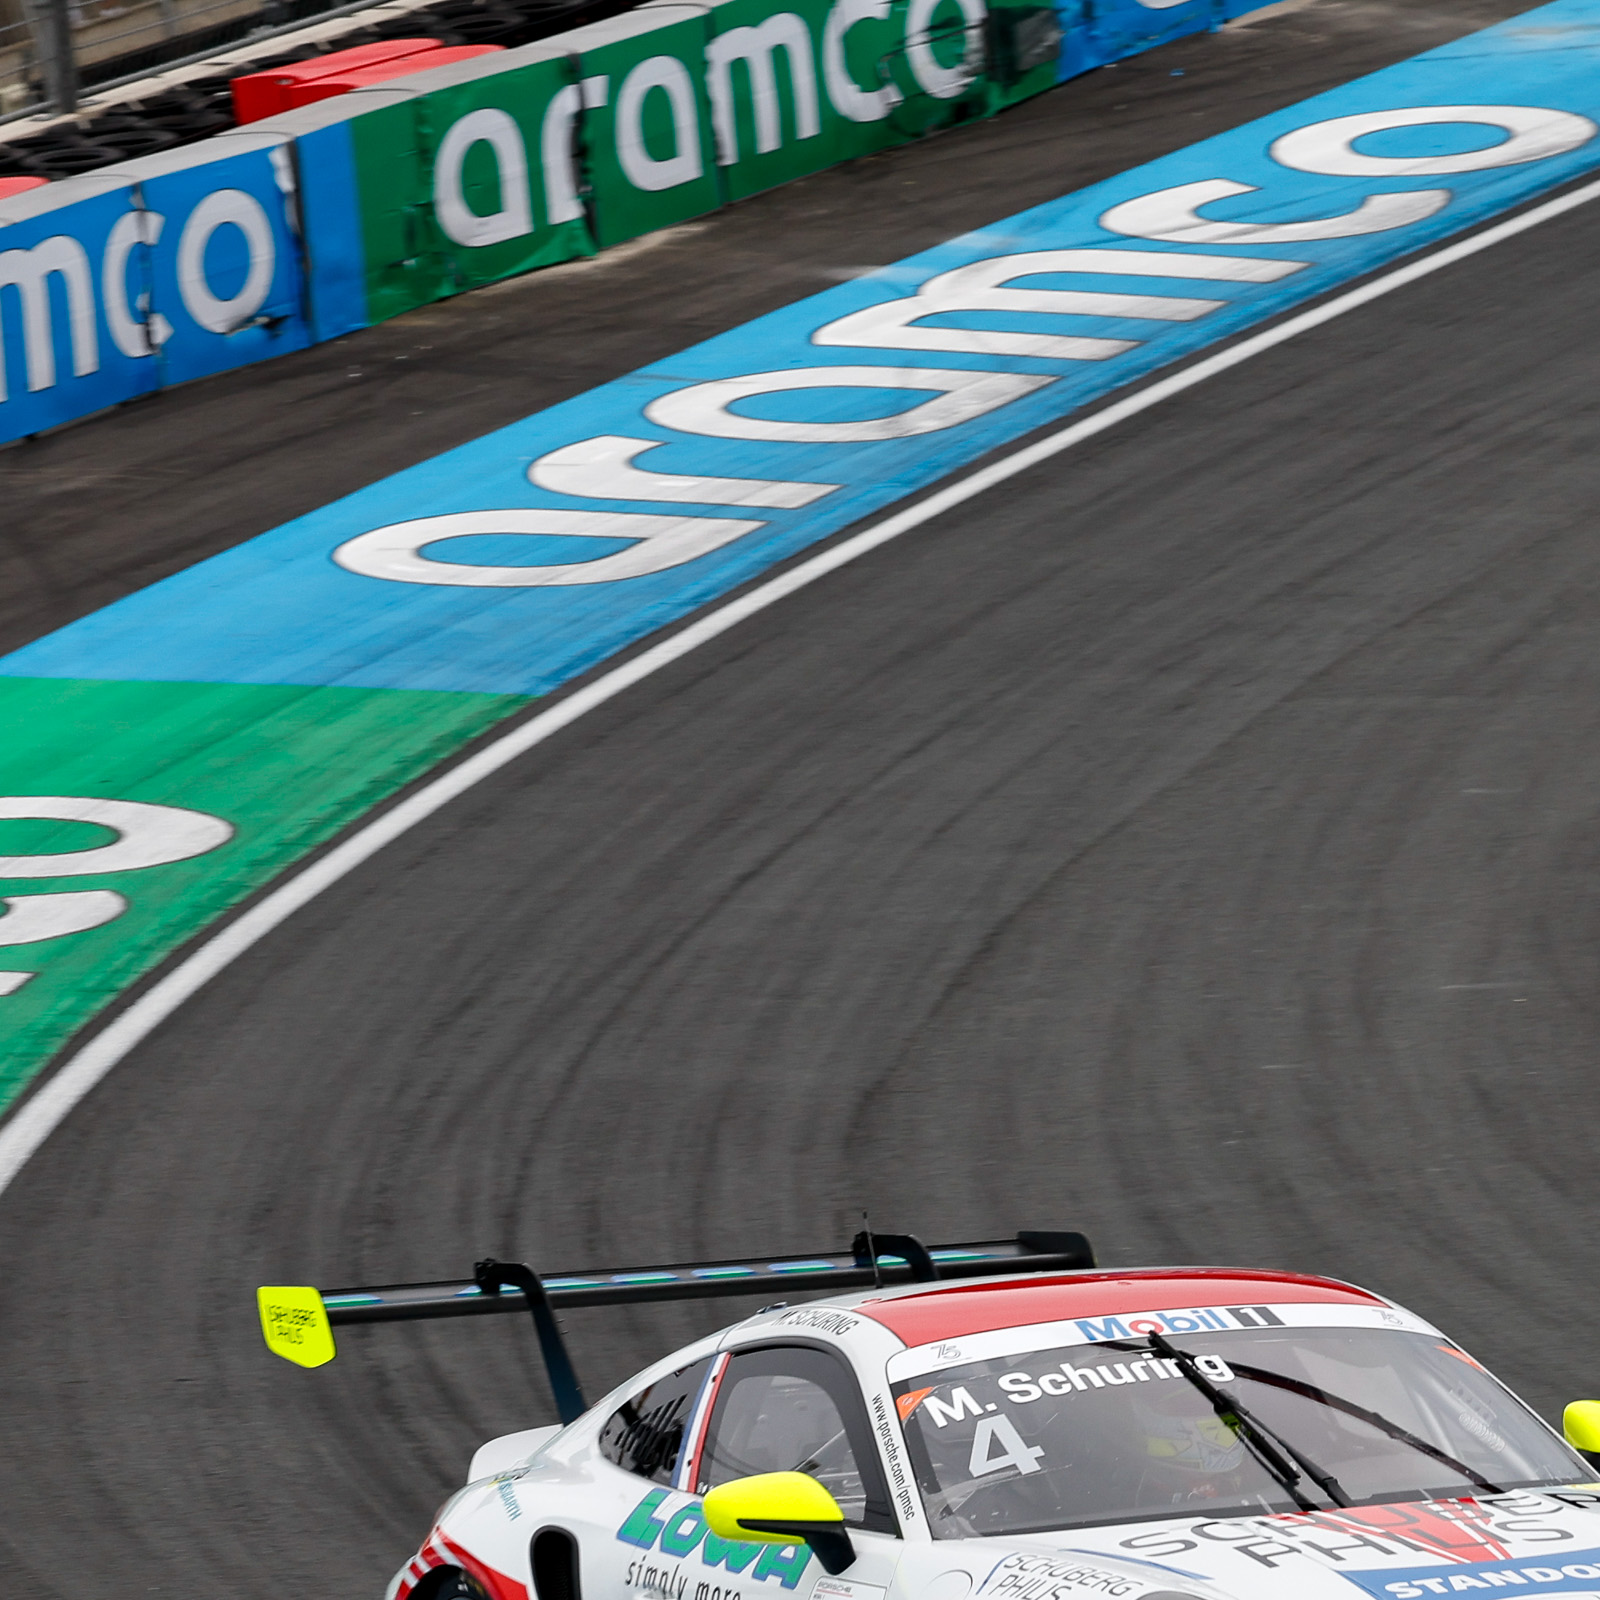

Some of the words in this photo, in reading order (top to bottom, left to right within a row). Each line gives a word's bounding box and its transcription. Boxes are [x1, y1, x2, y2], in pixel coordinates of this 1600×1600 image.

[433, 0, 988, 247] aramco
[332, 104, 1597, 588] aramco
[788, 1309, 860, 1336] SCHURING
[1074, 1308, 1230, 1342] Mobil
[923, 1385, 999, 1429] M.
[870, 1393, 916, 1521] www.porsche.com/pmsc
[968, 1413, 1046, 1479] 4
[1003, 1554, 1145, 1597] SCHUBERG
